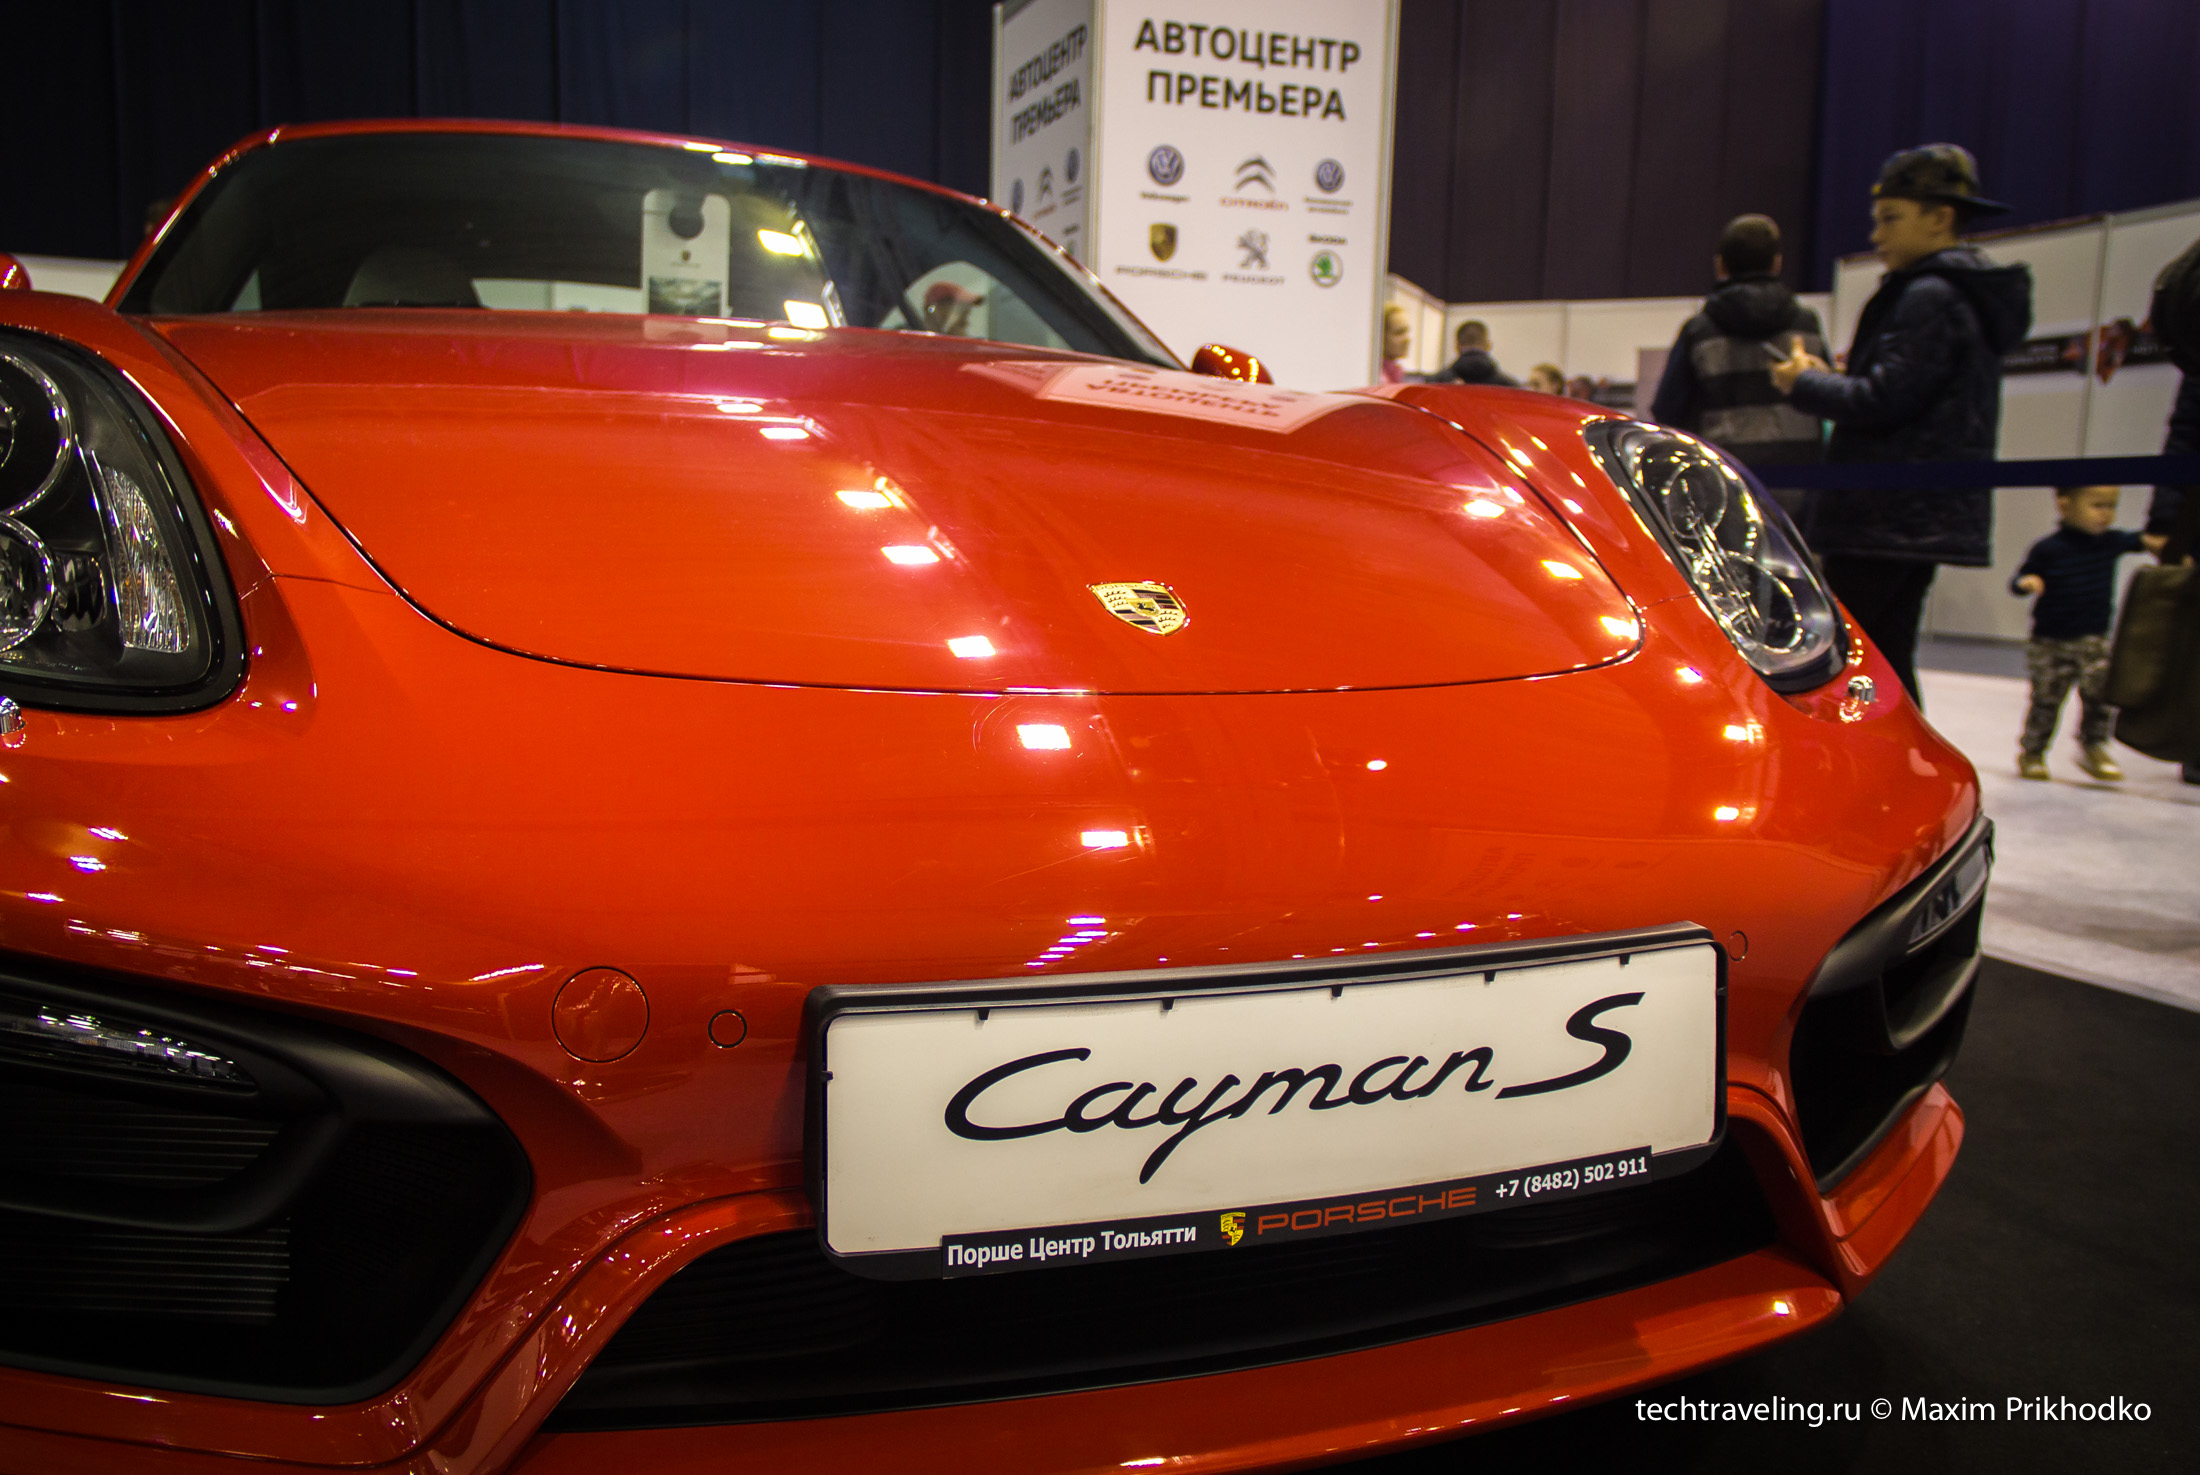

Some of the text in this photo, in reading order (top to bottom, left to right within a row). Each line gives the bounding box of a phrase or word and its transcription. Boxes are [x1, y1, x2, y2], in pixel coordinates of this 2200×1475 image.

[1009, 23, 1088, 102] АВТОЦЕНТР
[1133, 17, 1361, 72] АВТОЦЕНТР
[1010, 76, 1081, 145] ПРЕМЬЕРА
[1146, 69, 1347, 121] ПРЕМЬЕРА
[943, 991, 1647, 1184] Cayman S
[1495, 1156, 1648, 1199] +7 (8482) 502 911
[1258, 1186, 1477, 1235] PORSCHE
[948, 1226, 1197, 1268] Порше Центр Тольятти
